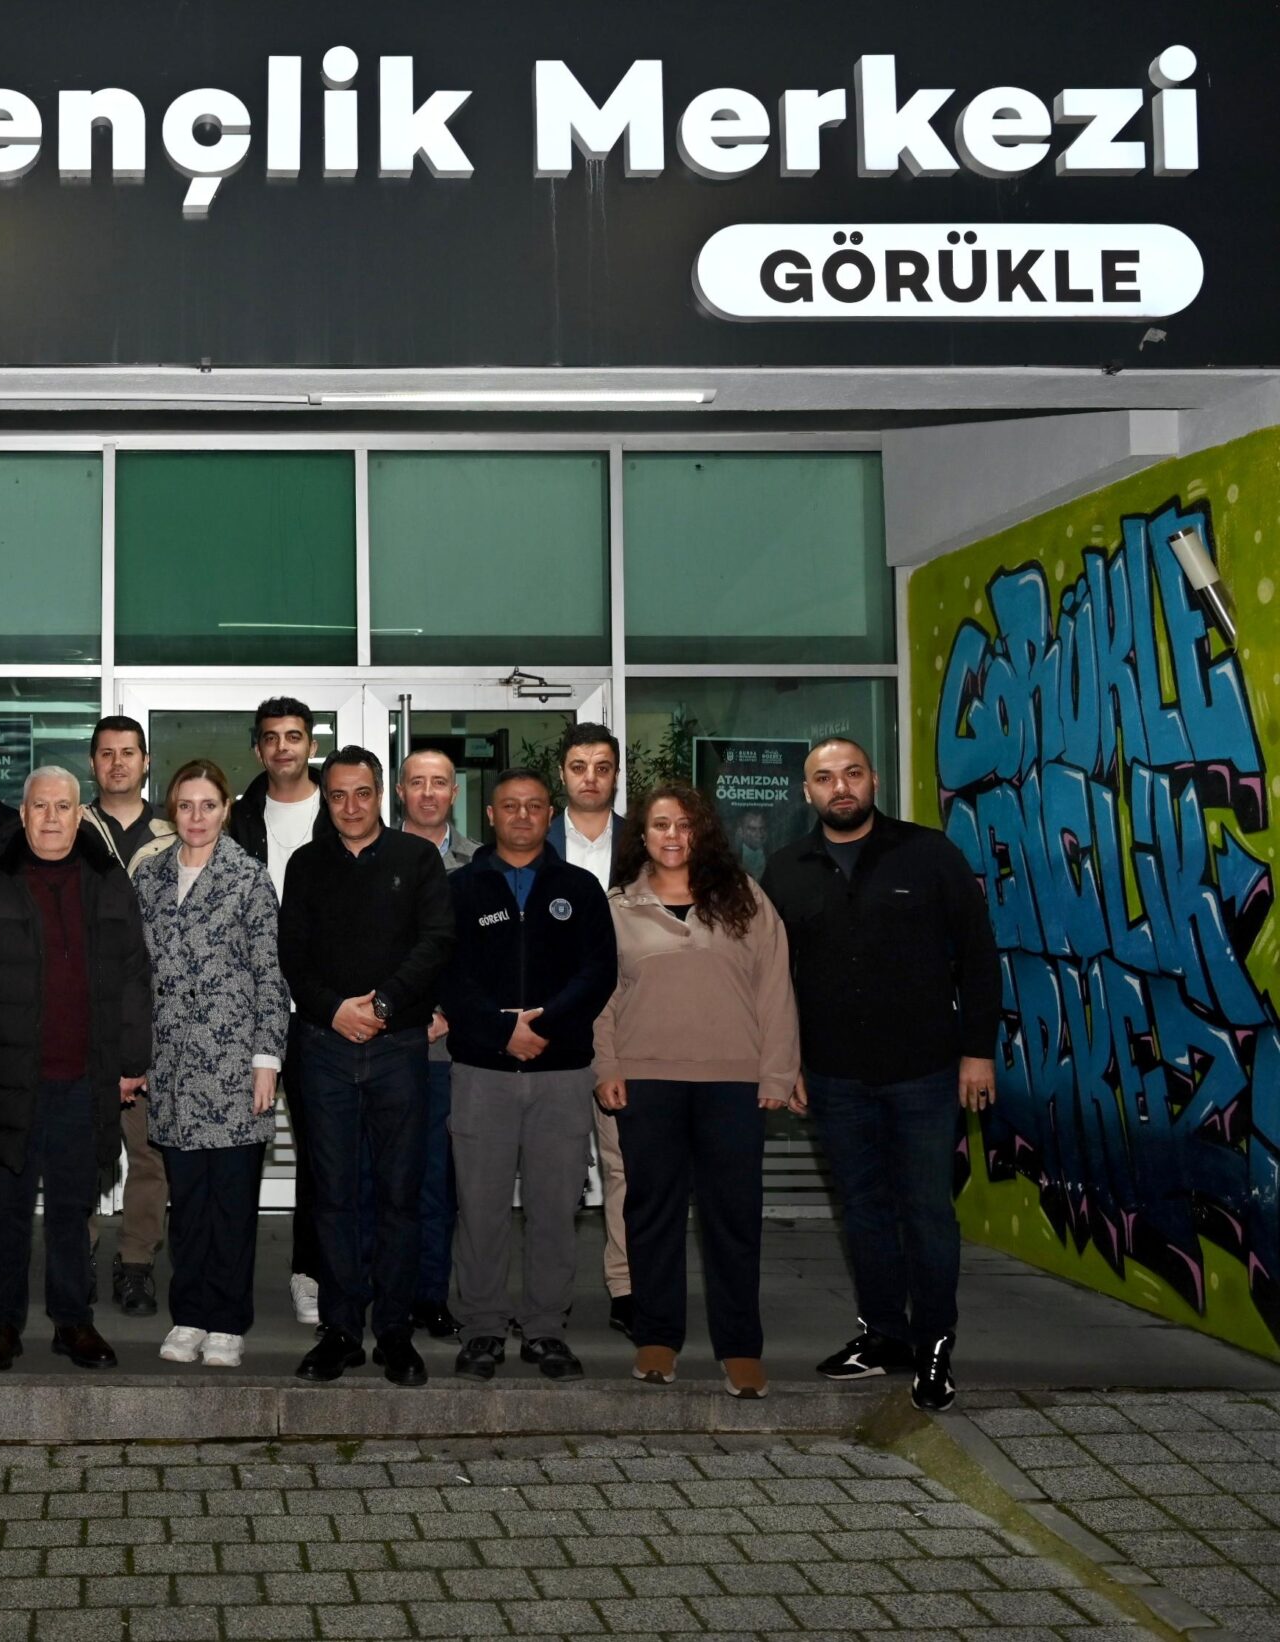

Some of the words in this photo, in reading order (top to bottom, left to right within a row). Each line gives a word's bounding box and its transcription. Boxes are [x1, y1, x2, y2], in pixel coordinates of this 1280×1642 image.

[532, 44, 1199, 179] Merkezi
[759, 230, 1142, 304] GÖRÜKLE
[716, 774, 789, 786] ATAMIZDAN
[715, 785, 789, 800] ÖĞRENDİK
[478, 908, 510, 927] GÖREVLİ
